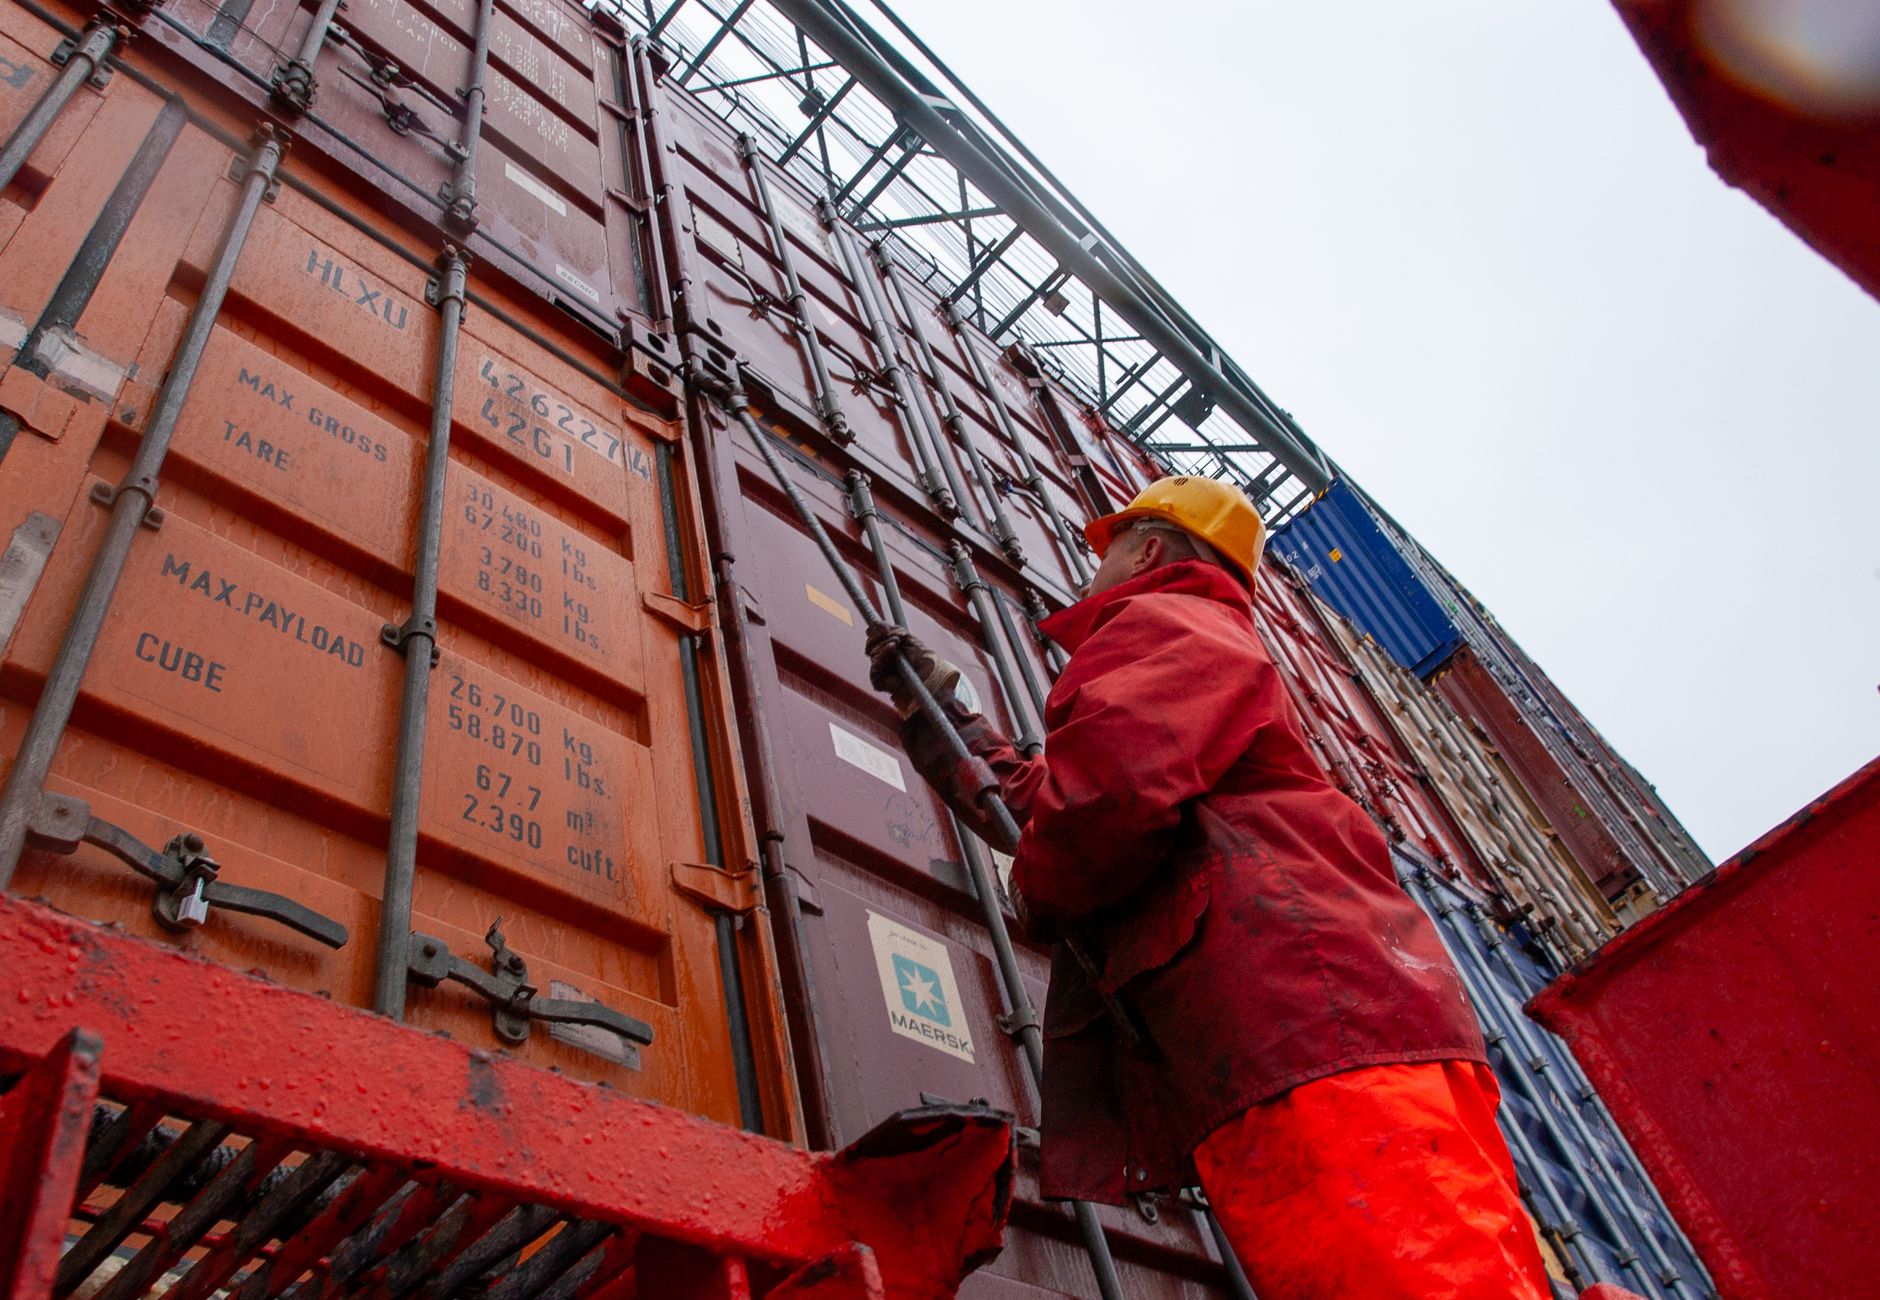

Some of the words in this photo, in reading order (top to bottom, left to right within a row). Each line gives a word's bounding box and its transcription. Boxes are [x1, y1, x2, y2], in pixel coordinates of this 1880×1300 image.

[306, 249, 408, 330] HLXU
[223, 419, 291, 472] TARE
[308, 407, 388, 463] GROSS
[481, 398, 573, 474] 42G1
[465, 505, 542, 560] 67.200
[478, 570, 543, 619] 8.330
[480, 546, 542, 594] 3.780
[135, 632, 226, 693] CUBE
[450, 675, 541, 736] 26.700
[449, 705, 541, 766] 58.870
[462, 794, 542, 849] 2.390
[890, 1010, 972, 1053] MAERSK
